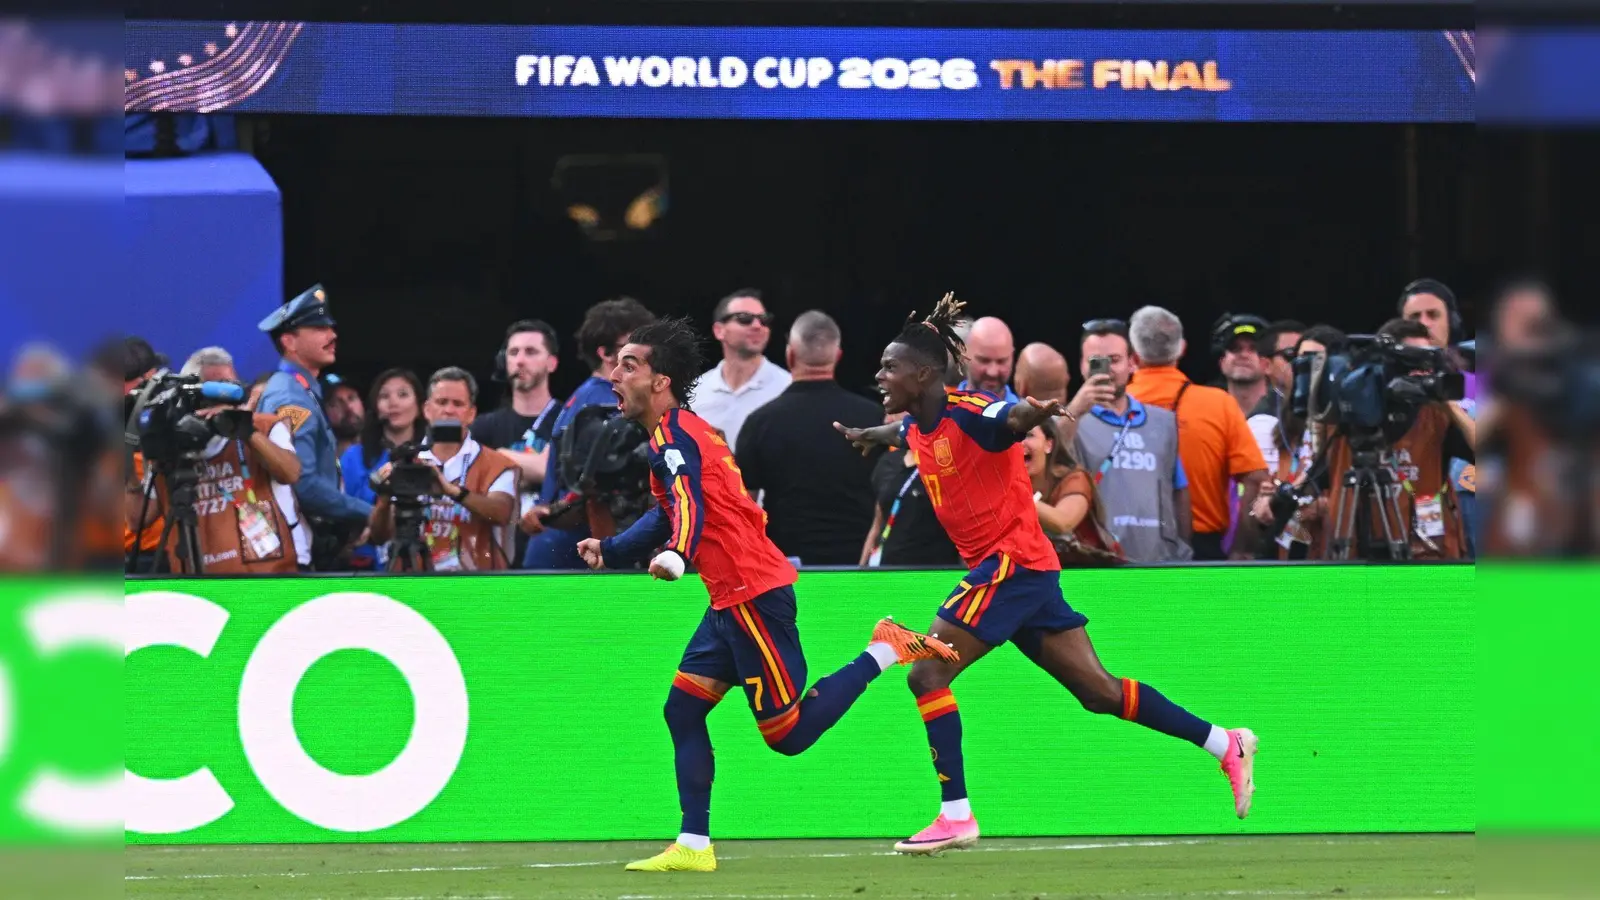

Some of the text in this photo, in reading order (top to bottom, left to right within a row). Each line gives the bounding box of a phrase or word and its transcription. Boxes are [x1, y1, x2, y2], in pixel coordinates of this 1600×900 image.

[515, 54, 1232, 92] FIFA WORLD CUP 2026 THE FINAL
[1112, 449, 1157, 472] 1290
[923, 474, 942, 507] 17
[203, 548, 239, 566] FA.com
[941, 580, 973, 609] 7
[745, 676, 764, 711] 7
